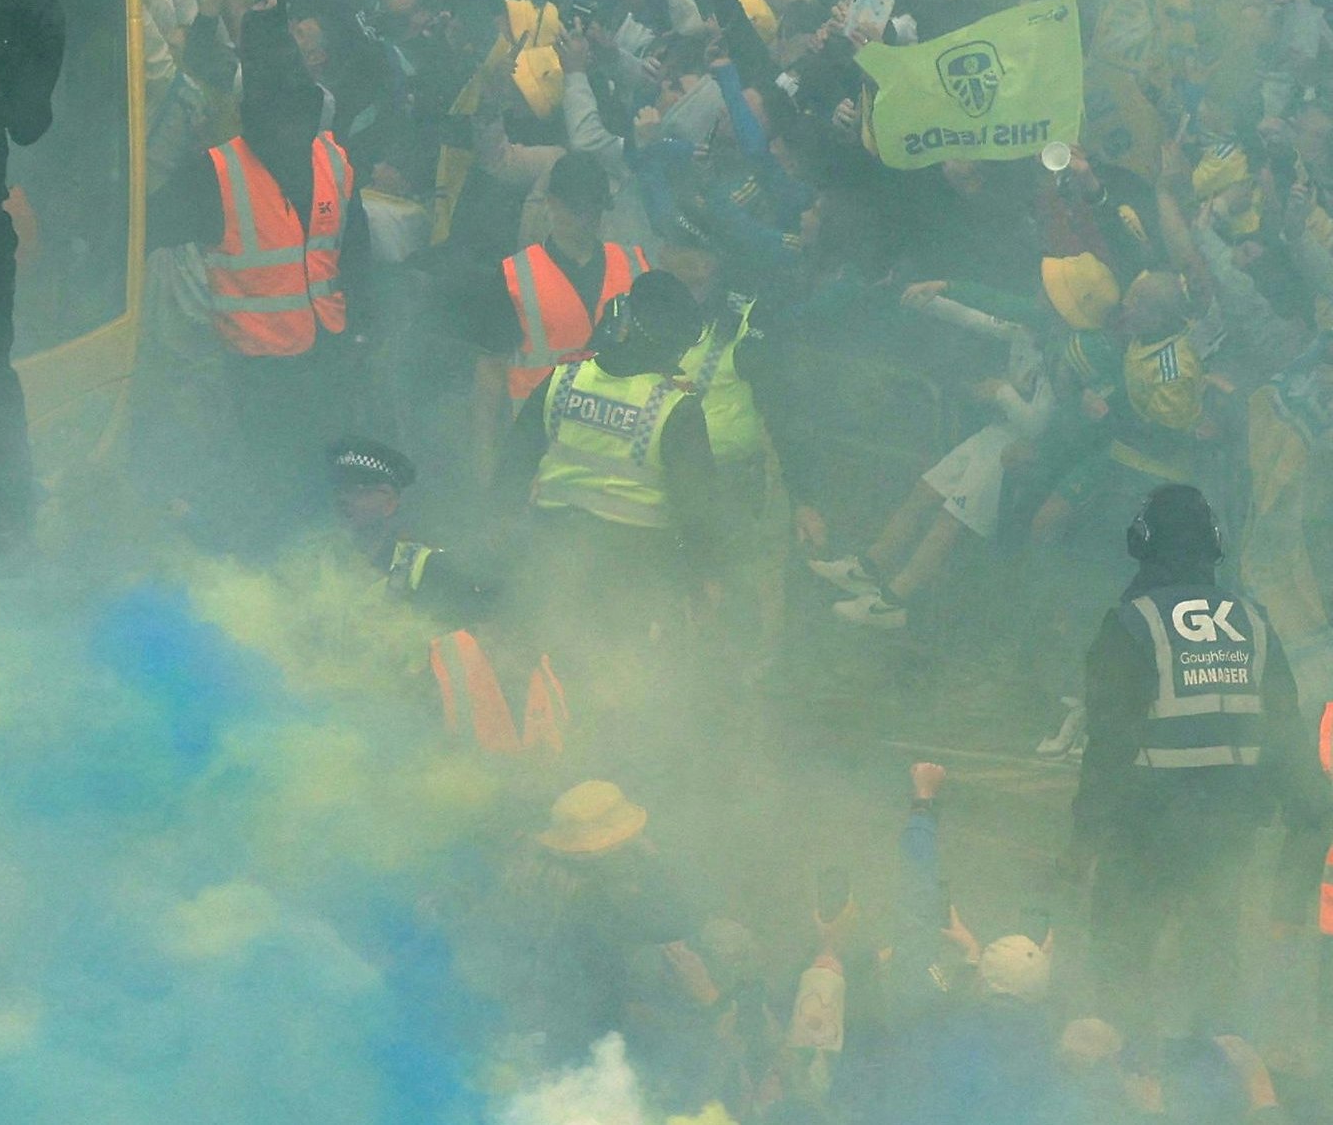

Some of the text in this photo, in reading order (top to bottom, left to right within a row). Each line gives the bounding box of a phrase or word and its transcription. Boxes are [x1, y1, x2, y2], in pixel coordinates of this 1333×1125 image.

[567, 394, 637, 430] POLICE
[1172, 599, 1247, 642] GK
[1183, 668, 1249, 686] MANAGER
